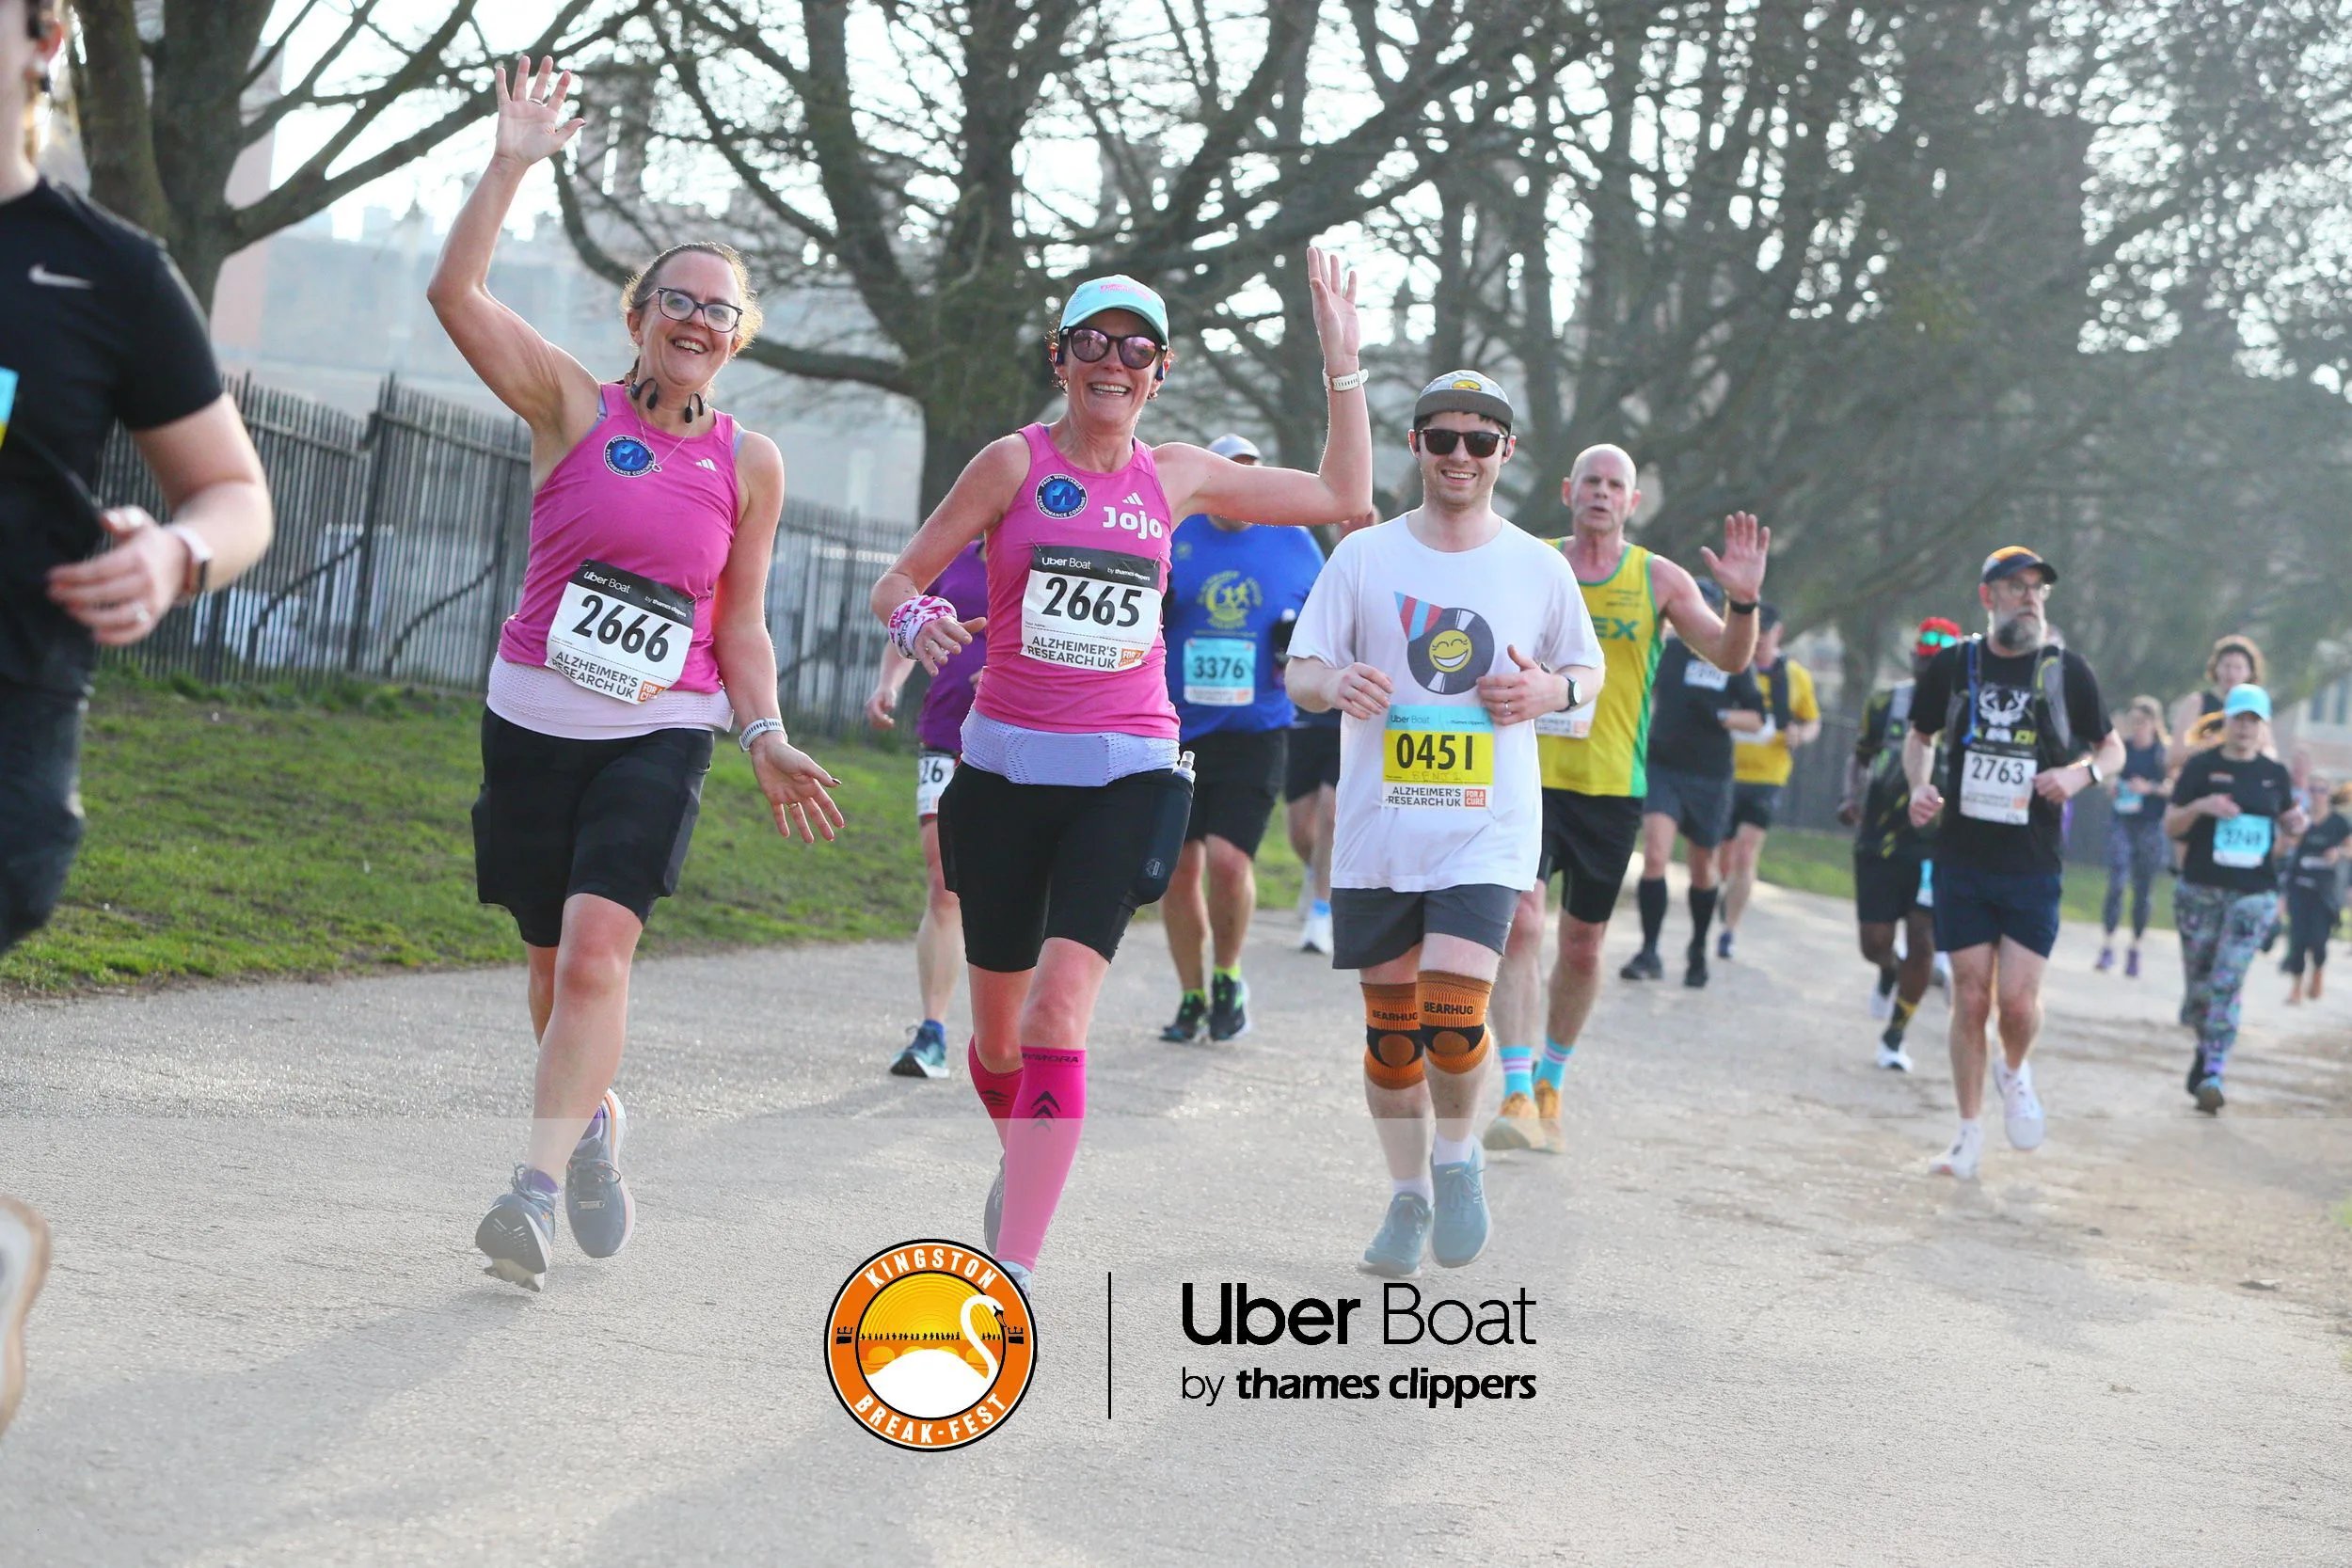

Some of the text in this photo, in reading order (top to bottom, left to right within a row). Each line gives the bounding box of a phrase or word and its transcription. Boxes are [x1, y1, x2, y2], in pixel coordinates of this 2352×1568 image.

[1103, 506, 1163, 540] Jojo
[1041, 556, 1091, 570] Uber Boat
[583, 571, 631, 594] Uber Boat
[1041, 577, 1143, 627] 2665
[571, 594, 673, 663] 2666
[1026, 645, 1094, 666] RESEARCH
[1097, 658, 1116, 669] UK
[1032, 635, 1118, 657] ALZHEIMER'S
[551, 657, 635, 699] RESEARCH UK
[555, 651, 639, 688] ALZHEIMER'S
[1193, 656, 1245, 679] 3376
[1396, 733, 1473, 770] 0451
[1971, 756, 2025, 784] 2763
[1388, 796, 1461, 807] RESEARCH UK
[1392, 786, 1461, 797] ALZHEIMER'S
[1423, 1002, 1473, 1015] BEARHUG
